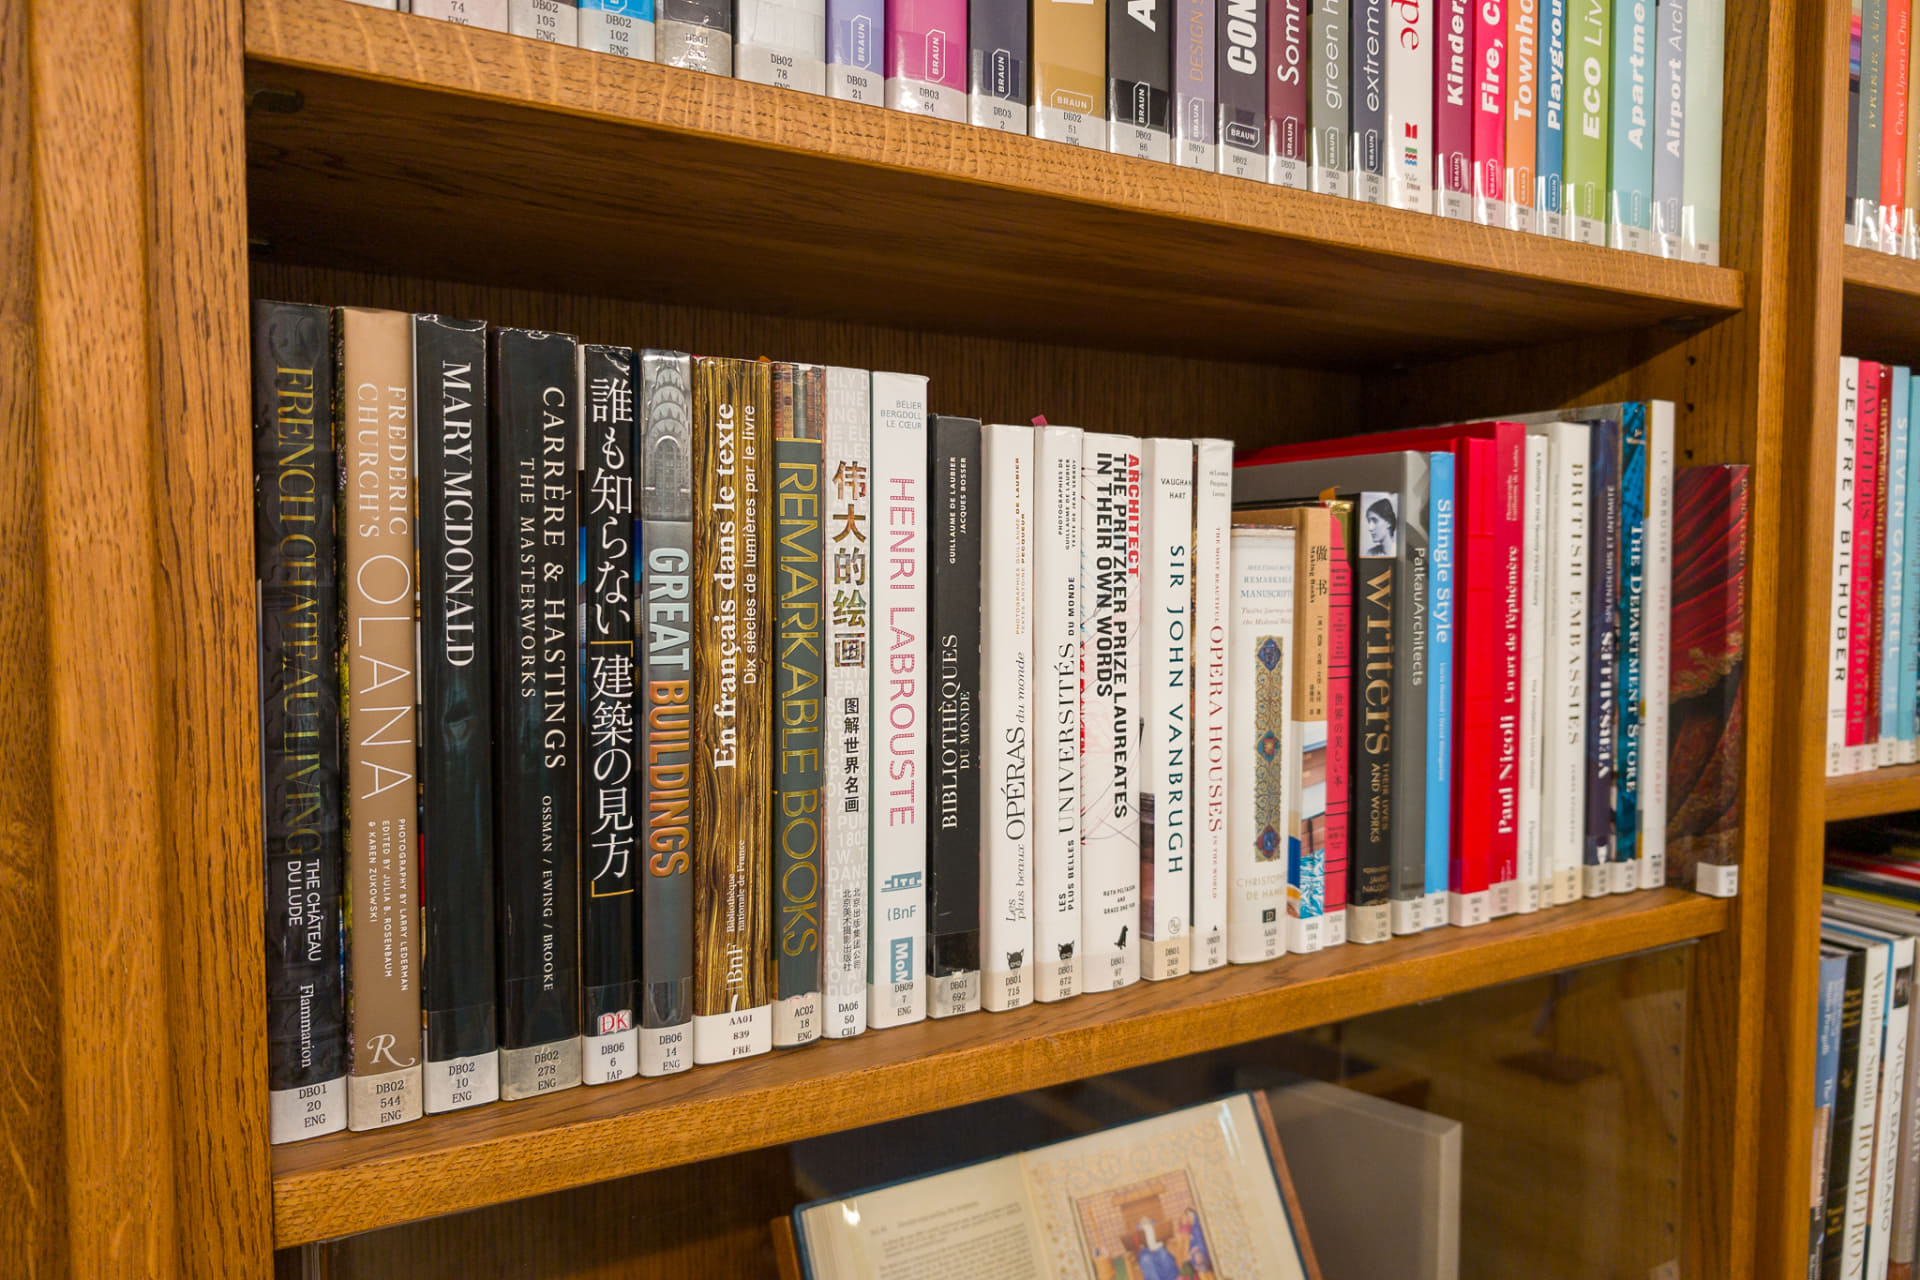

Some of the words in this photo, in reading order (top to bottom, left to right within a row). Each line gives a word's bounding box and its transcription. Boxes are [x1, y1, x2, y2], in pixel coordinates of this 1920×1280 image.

[536, 14, 556, 27] 105
[605, 14, 632, 28] DB02
[609, 30, 629, 42] 102
[856, 22, 866, 63] BRAUN
[1898, 10, 1907, 46] Chair
[770, 53, 793, 68] DB02
[931, 36, 940, 76] BRAUN
[1190, 11, 1204, 82] DESIGN
[1326, 25, 1342, 110] green
[846, 74, 868, 88] DB03
[997, 55, 1005, 93] BRAUN
[1482, 39, 1503, 114] Fire,
[1583, 57, 1602, 139] ECO
[1897, 59, 1908, 96] Upon
[1056, 95, 1088, 111] BRAUN
[1666, 57, 1684, 158] Airport
[1895, 102, 1906, 136] Once
[1230, 127, 1256, 141] BRAUN
[1286, 123, 1294, 157] BRAUN
[443, 360, 473, 465] MARY
[742, 405, 755, 442] livre
[880, 409, 922, 420] BERGDOLL
[886, 420, 897, 429] LE
[898, 420, 922, 430] CŒUR
[896, 400, 922, 410] BELIER
[277, 366, 316, 524] FRENCH
[357, 383, 380, 537] CHURCH'S
[387, 386, 408, 536] FREDERIC
[715, 403, 735, 477] texte
[742, 446, 756, 461] le
[1097, 453, 1112, 475] IN
[1841, 378, 1857, 513] JEFFREY
[519, 457, 535, 504] THE
[543, 386, 572, 546] CARRÈRE
[745, 468, 759, 495] par
[1113, 453, 1127, 497] THE
[1161, 477, 1192, 487] VAUGHAN
[1892, 417, 1908, 523] STEVEN
[713, 486, 735, 512] le
[949, 498, 956, 509] DE
[1097, 482, 1112, 549] THEIR
[1128, 454, 1140, 577] ARCHITECT
[1169, 491, 1187, 500] HART
[742, 497, 757, 568] lumières
[889, 478, 915, 590] HENRI
[1433, 499, 1453, 582] Shingle
[1570, 463, 1584, 577] BRITISH
[443, 468, 475, 667] MCDONALD
[713, 520, 736, 591] dans
[832, 460, 867, 668] 伟大的绘画
[1113, 503, 1127, 613] PRITZKER
[1169, 545, 1185, 588] SIR
[1630, 523, 1643, 566] THE
[544, 562, 565, 582] &
[743, 574, 757, 593] de
[1097, 556, 1112, 608] OWN
[1604, 551, 1614, 624] SPLENDEURS
[1888, 529, 1904, 660] GAMBREL
[520, 516, 536, 698] MASTERWORKS
[649, 547, 690, 671] GREAT
[743, 599, 757, 654] siècles
[779, 462, 818, 775] REMARKABLE
[1412, 547, 1426, 687] PatkauArchitects
[1432, 588, 1452, 643] Style
[1834, 530, 1852, 683] BILHUBER
[713, 599, 742, 719] français
[1097, 616, 1113, 697] WORDS
[1113, 621, 1127, 684] PRIZE
[1166, 606, 1184, 687] JOHN
[1364, 566, 1393, 755] Writers
[1504, 655, 1517, 677] art
[1505, 633, 1517, 651] de
[1628, 575, 1643, 716] DEPARTMENT
[356, 554, 413, 800] OLANA
[544, 598, 566, 769] HASTINGS
[743, 658, 757, 685] Dix
[1015, 651, 1025, 704] monde
[1209, 625, 1224, 716] OPERA
[1504, 680, 1516, 703] Un
[1567, 591, 1583, 745] EMBASSIES
[889, 606, 916, 827] LABROUSTE
[960, 691, 970, 744] MONDE
[1015, 705, 1025, 723] du
[1053, 643, 1075, 833] UNIVERSITÉS
[1068, 621, 1075, 636] DU
[1597, 631, 1613, 779] VERSAILLES
[713, 726, 737, 770] En
[844, 697, 860, 813] 图解世界名画
[939, 634, 961, 830] BIBLIOTHÈQUES
[1114, 692, 1128, 818] LAUREATES
[1499, 714, 1515, 781] Nicoli
[649, 679, 690, 877] BUILDINGS
[960, 753, 970, 770] DU
[1208, 726, 1223, 832] HOUSES
[1371, 763, 1382, 792] AND
[1382, 762, 1390, 796] THEIR
[1625, 723, 1639, 793] STORE
[283, 730, 322, 857] LIVING
[1001, 727, 1025, 841] OPÉRAS
[1168, 704, 1183, 873] VANBRUGH
[542, 795, 553, 853] OSSMAN
[1370, 795, 1382, 843] WORKS
[1382, 799, 1390, 831] LIVES
[1498, 786, 1514, 835] Paul
[368, 831, 377, 864] KAREN
[382, 820, 390, 855] EDITED
[398, 818, 407, 890] PHOTOGRAPHY
[737, 839, 745, 872] France
[1067, 840, 1075, 879] BELLES
[287, 860, 302, 886] DU
[305, 858, 321, 889] THE
[382, 859, 391, 871] BY
[383, 874, 391, 903] JULIA
[738, 874, 745, 886] de
[782, 788, 818, 957] BOOKS
[1015, 844, 1025, 887] beaux
[288, 886, 303, 927] LUDE
[369, 868, 377, 923] ZUKOWSKI
[399, 893, 407, 905] BY
[543, 870, 554, 918] EWING
[726, 873, 736, 933] Bibliothèque
[1006, 898, 1016, 922] Les
[1015, 890, 1026, 921] plus
[1058, 893, 1067, 913] LES
[1067, 883, 1075, 910] PLUS
[306, 891, 322, 962] CHÂTEAU
[399, 908, 408, 938] LARRY
[384, 918, 392, 978] ROSENBAUM
[400, 941, 408, 991] LEDERMAN
[543, 934, 554, 992] BROOKE
[726, 943, 743, 984] BnF
[300, 983, 315, 1069] Flammarion
[601, 1011, 630, 1034] DK
[729, 1014, 754, 1025] AA01
[733, 1030, 750, 1040] 839
[367, 1033, 415, 1068] R
[534, 1051, 559, 1065] DB02
[537, 1065, 556, 1077] 278
[732, 1044, 752, 1056] FRE
[1892, 1038, 1906, 1106] VILLA
[299, 1085, 327, 1099] DB01
[376, 1080, 404, 1095] DB02
[380, 1095, 401, 1108] 544
[537, 1078, 556, 1091] ENG
[380, 1109, 402, 1123] ENG
[1881, 1111, 1902, 1233] BALBIANO
